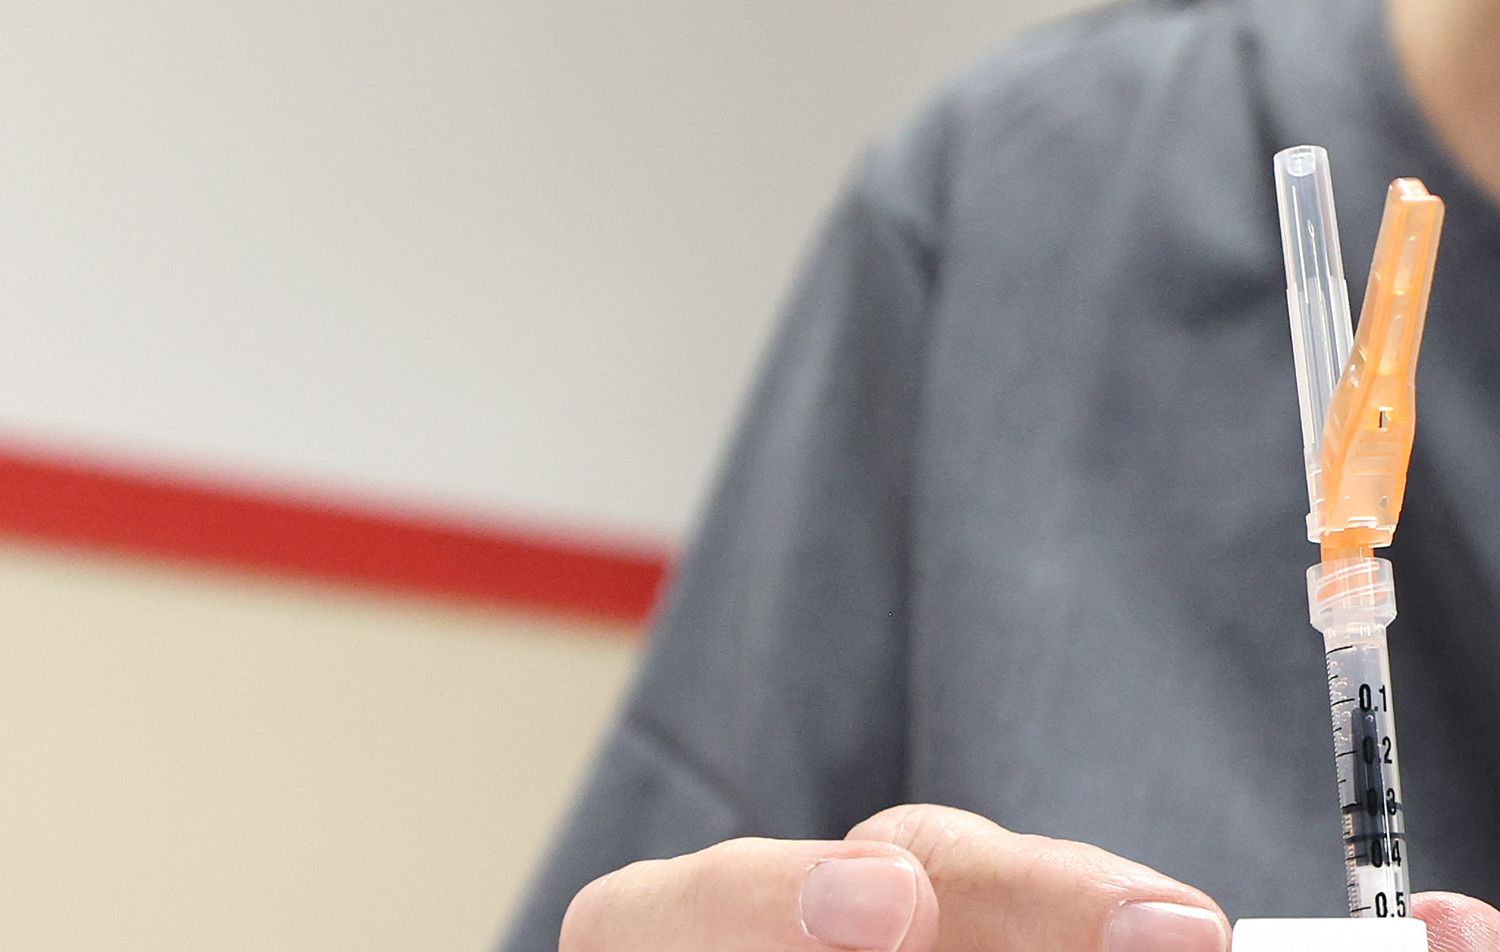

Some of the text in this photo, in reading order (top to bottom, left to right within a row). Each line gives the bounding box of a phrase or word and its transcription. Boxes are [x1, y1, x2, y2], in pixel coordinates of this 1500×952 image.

[1359, 684, 1387, 712] 0.1
[1362, 735, 1392, 765] 0.2
[1371, 840, 1401, 868] 0.4
[1375, 891, 1406, 918] 0.5
